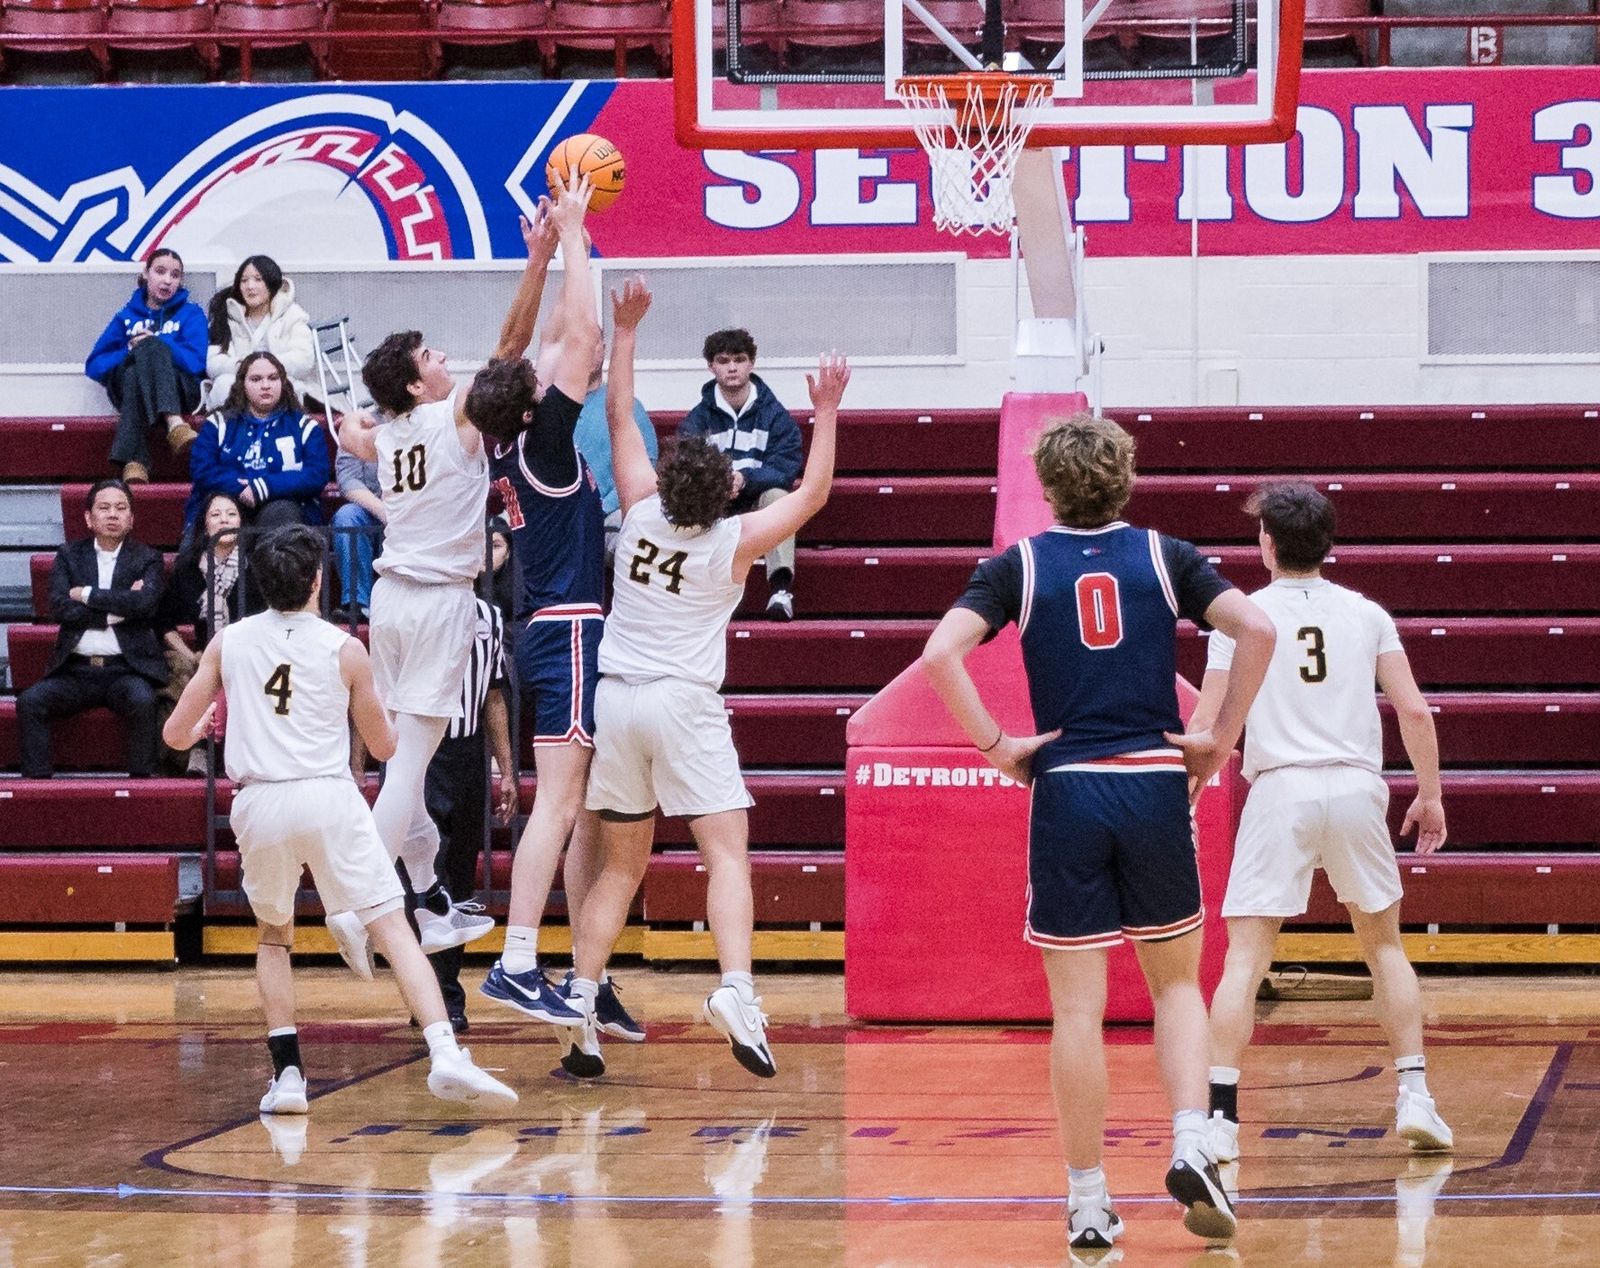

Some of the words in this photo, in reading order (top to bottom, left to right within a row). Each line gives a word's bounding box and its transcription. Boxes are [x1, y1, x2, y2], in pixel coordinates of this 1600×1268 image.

[1470, 25, 1497, 64] B
[391, 442, 427, 494] 10
[628, 536, 690, 596] 24
[1074, 571, 1123, 650] 0
[1296, 625, 1328, 684] 3
[263, 662, 293, 717] 4
